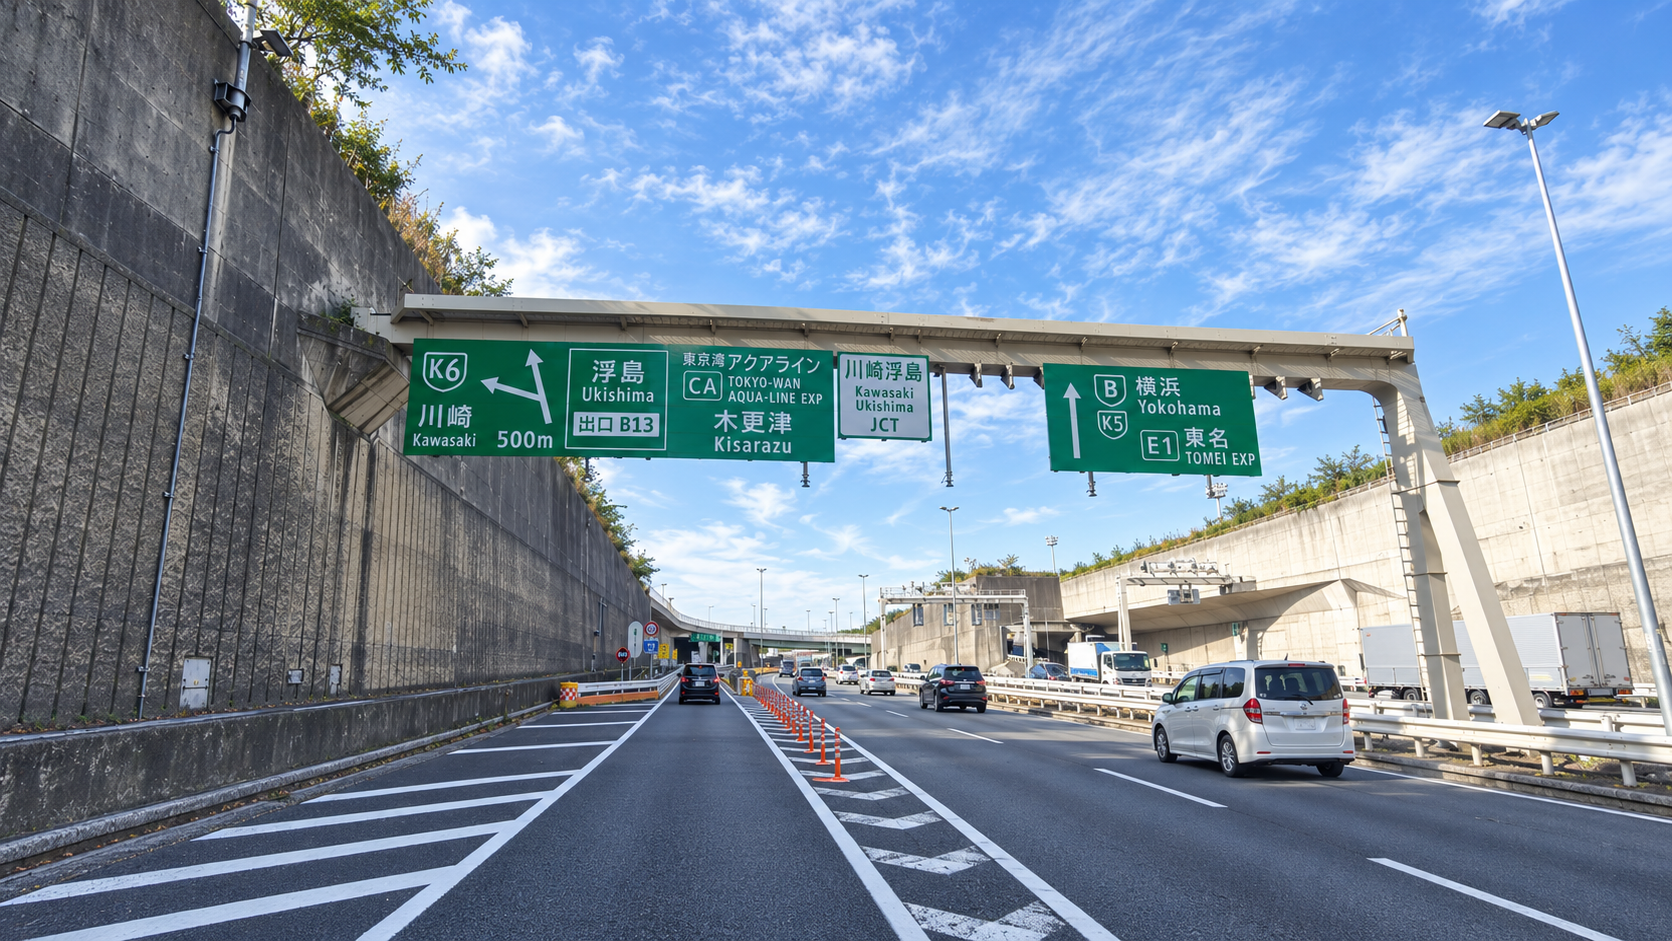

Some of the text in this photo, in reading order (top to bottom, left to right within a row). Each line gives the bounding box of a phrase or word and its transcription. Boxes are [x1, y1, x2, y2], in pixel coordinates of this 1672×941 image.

[429, 358, 460, 382] K6
[592, 359, 645, 384] 浮島
[845, 359, 922, 382] 川崎浮島
[688, 377, 717, 395] CA
[728, 376, 801, 389] TOKYO-WAN
[1104, 379, 1118, 398] B
[1135, 375, 1181, 397] 横浜
[582, 386, 654, 403] Ukishima
[728, 391, 823, 405] AQUA-LINE EXP
[855, 385, 914, 399] Kawasaki
[855, 399, 914, 413] Ukishima
[1137, 399, 1221, 416] Yokohama
[418, 404, 473, 429] 川崎
[579, 415, 654, 433] 出口 B13
[713, 409, 792, 435] 木更津
[870, 417, 900, 433] JCT
[1102, 415, 1123, 432] K5
[413, 433, 476, 447] Kawasaki
[497, 430, 553, 449] 500m
[714, 436, 792, 454] Kisarazu
[1147, 436, 1172, 455] E1
[1184, 426, 1228, 449] 東名
[1185, 451, 1256, 465] TOMEI EXP
